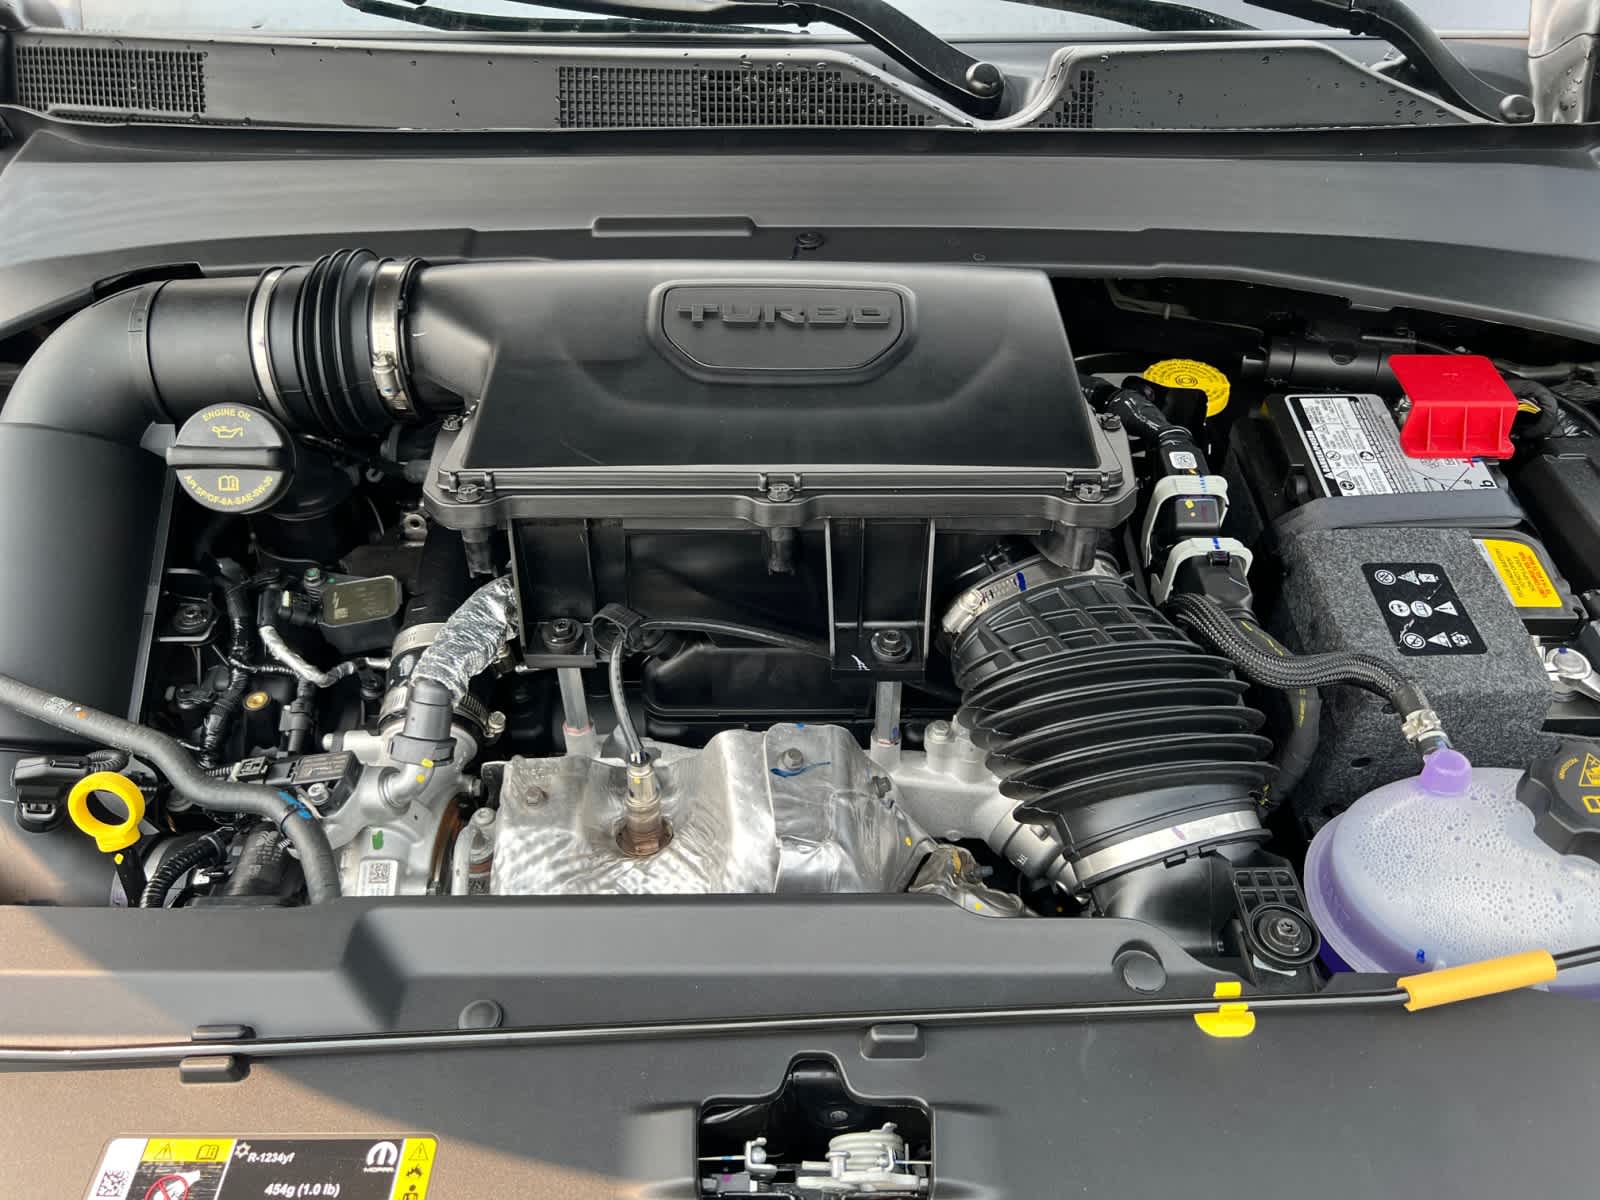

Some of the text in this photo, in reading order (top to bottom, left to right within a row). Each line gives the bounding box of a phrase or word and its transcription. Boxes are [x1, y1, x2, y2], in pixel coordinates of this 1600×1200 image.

[675, 303, 890, 325] TURBO
[202, 407, 252, 422] ENGINE OIL
[247, 1152, 295, 1165] R-1234yf
[264, 1183, 341, 1198] 454g (1.0 lb)
